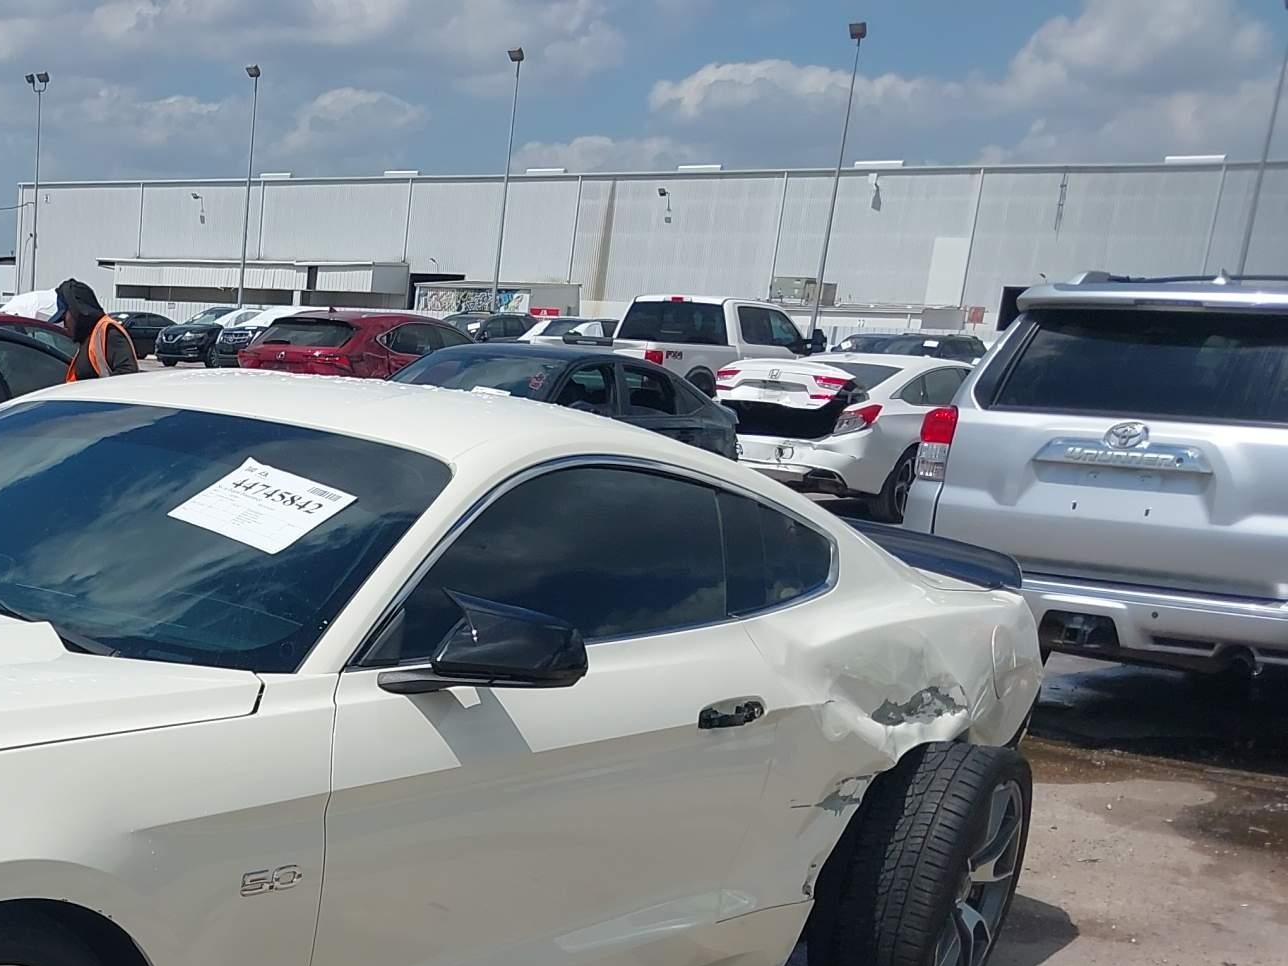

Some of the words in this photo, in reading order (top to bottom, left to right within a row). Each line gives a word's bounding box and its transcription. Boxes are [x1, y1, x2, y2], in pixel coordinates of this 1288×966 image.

[1064, 447, 1175, 469] 4RUNNER
[232, 478, 323, 514] 44745842
[240, 864, 302, 897] 5.0
